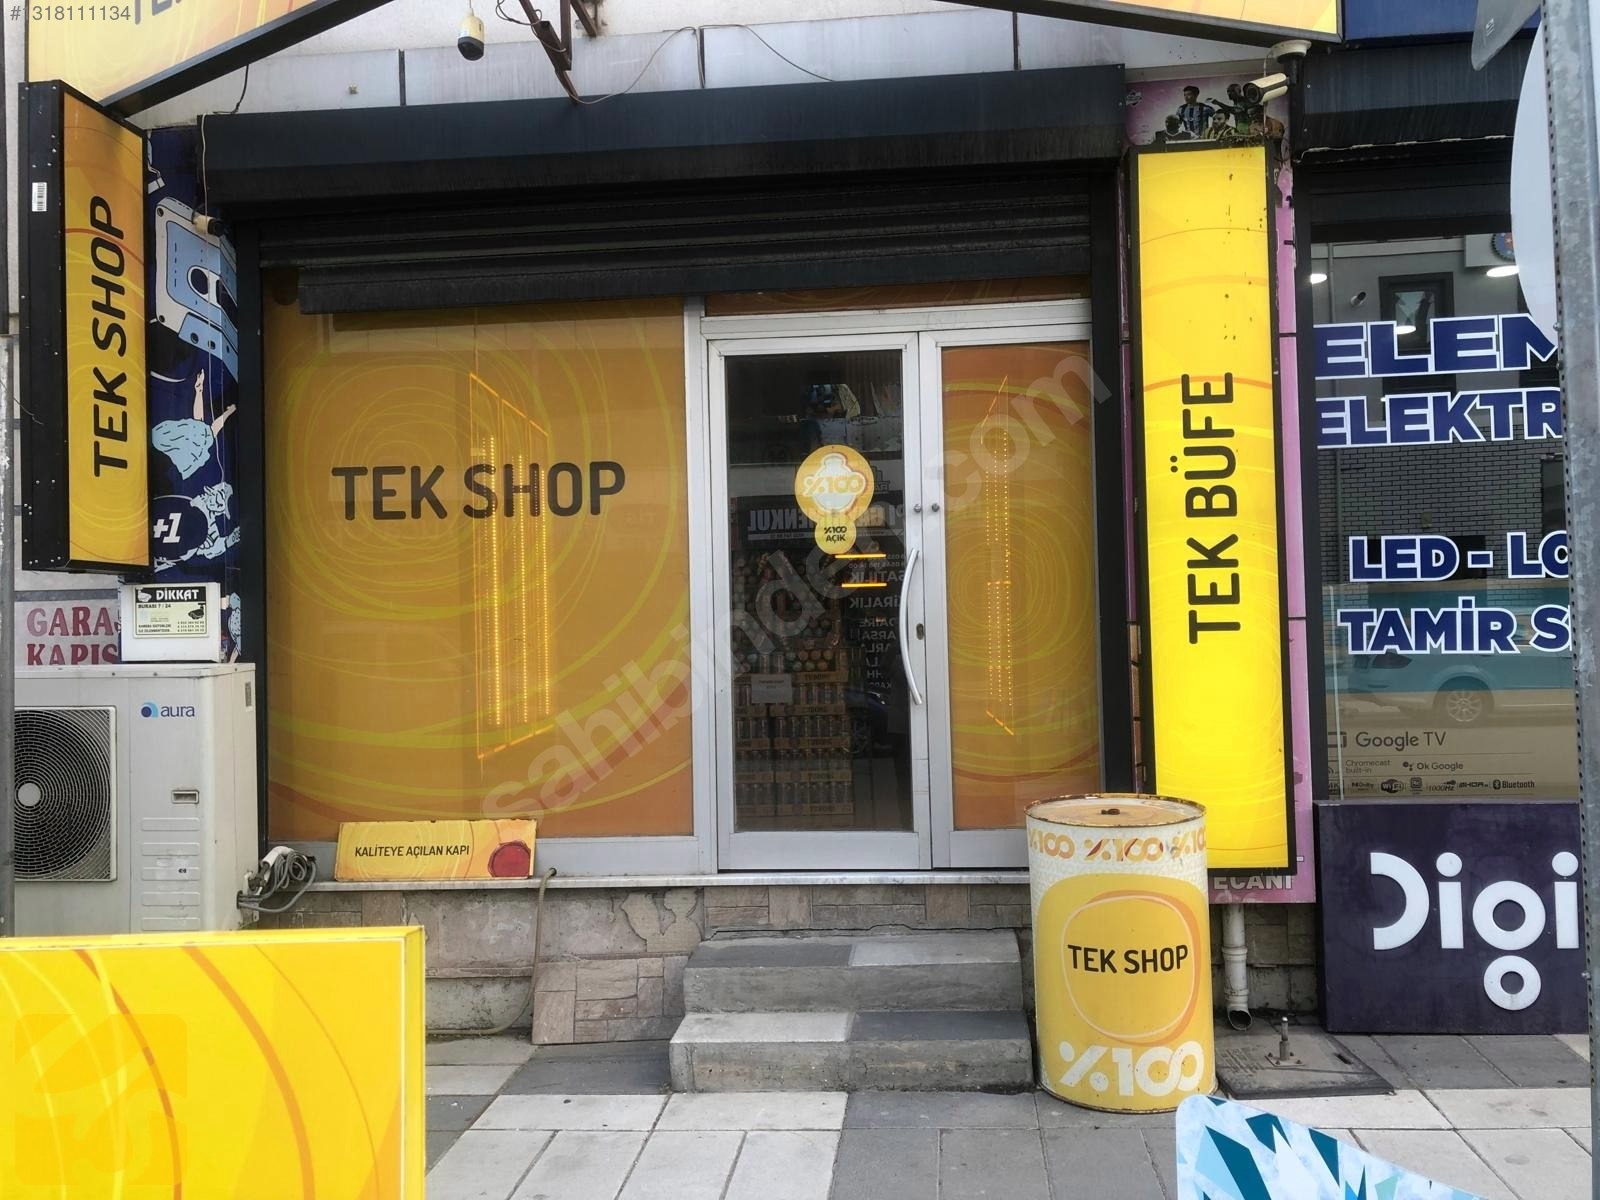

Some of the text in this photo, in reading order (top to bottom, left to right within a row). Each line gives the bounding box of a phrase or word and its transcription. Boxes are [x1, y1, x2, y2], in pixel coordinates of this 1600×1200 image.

[90, 195, 128, 478] TEK SHOP
[331, 461, 626, 520] TEK SHOP
[803, 475, 866, 498] %100
[1170, 372, 1241, 644] TEK BÜFE
[153, 513, 182, 543] +1
[825, 534, 846, 544] AÇIK
[1349, 535, 1460, 582] LED
[156, 587, 200, 601] DİKKAT
[1337, 596, 1572, 654] TAMİR S
[161, 704, 195, 718] aura
[1355, 731, 1447, 752] Google TV
[1431, 762, 1464, 771] Google
[355, 844, 470, 858] KALİTEYE AÇILAN KAPI
[1084, 837, 1164, 863] %100
[1067, 944, 1189, 974] TEK SHOP
[1059, 1040, 1204, 1097] %100
